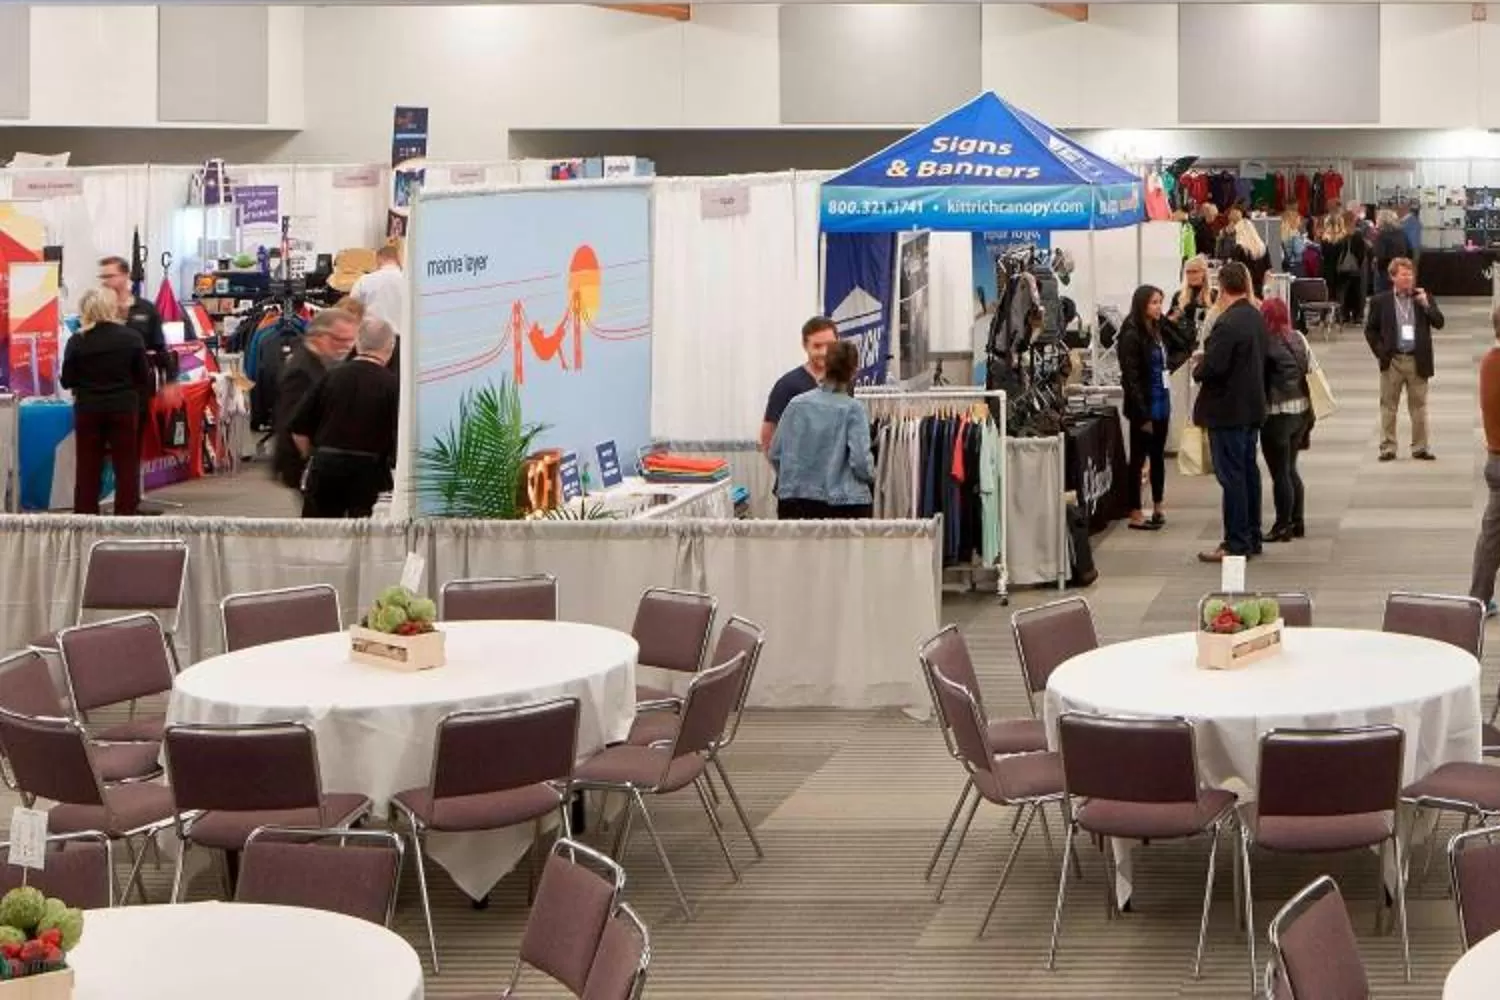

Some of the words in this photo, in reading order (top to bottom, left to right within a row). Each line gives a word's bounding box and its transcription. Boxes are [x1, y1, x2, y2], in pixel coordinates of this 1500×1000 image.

[930, 135, 1013, 156] Signs
[886, 158, 910, 178] &
[916, 159, 1041, 179] Banners
